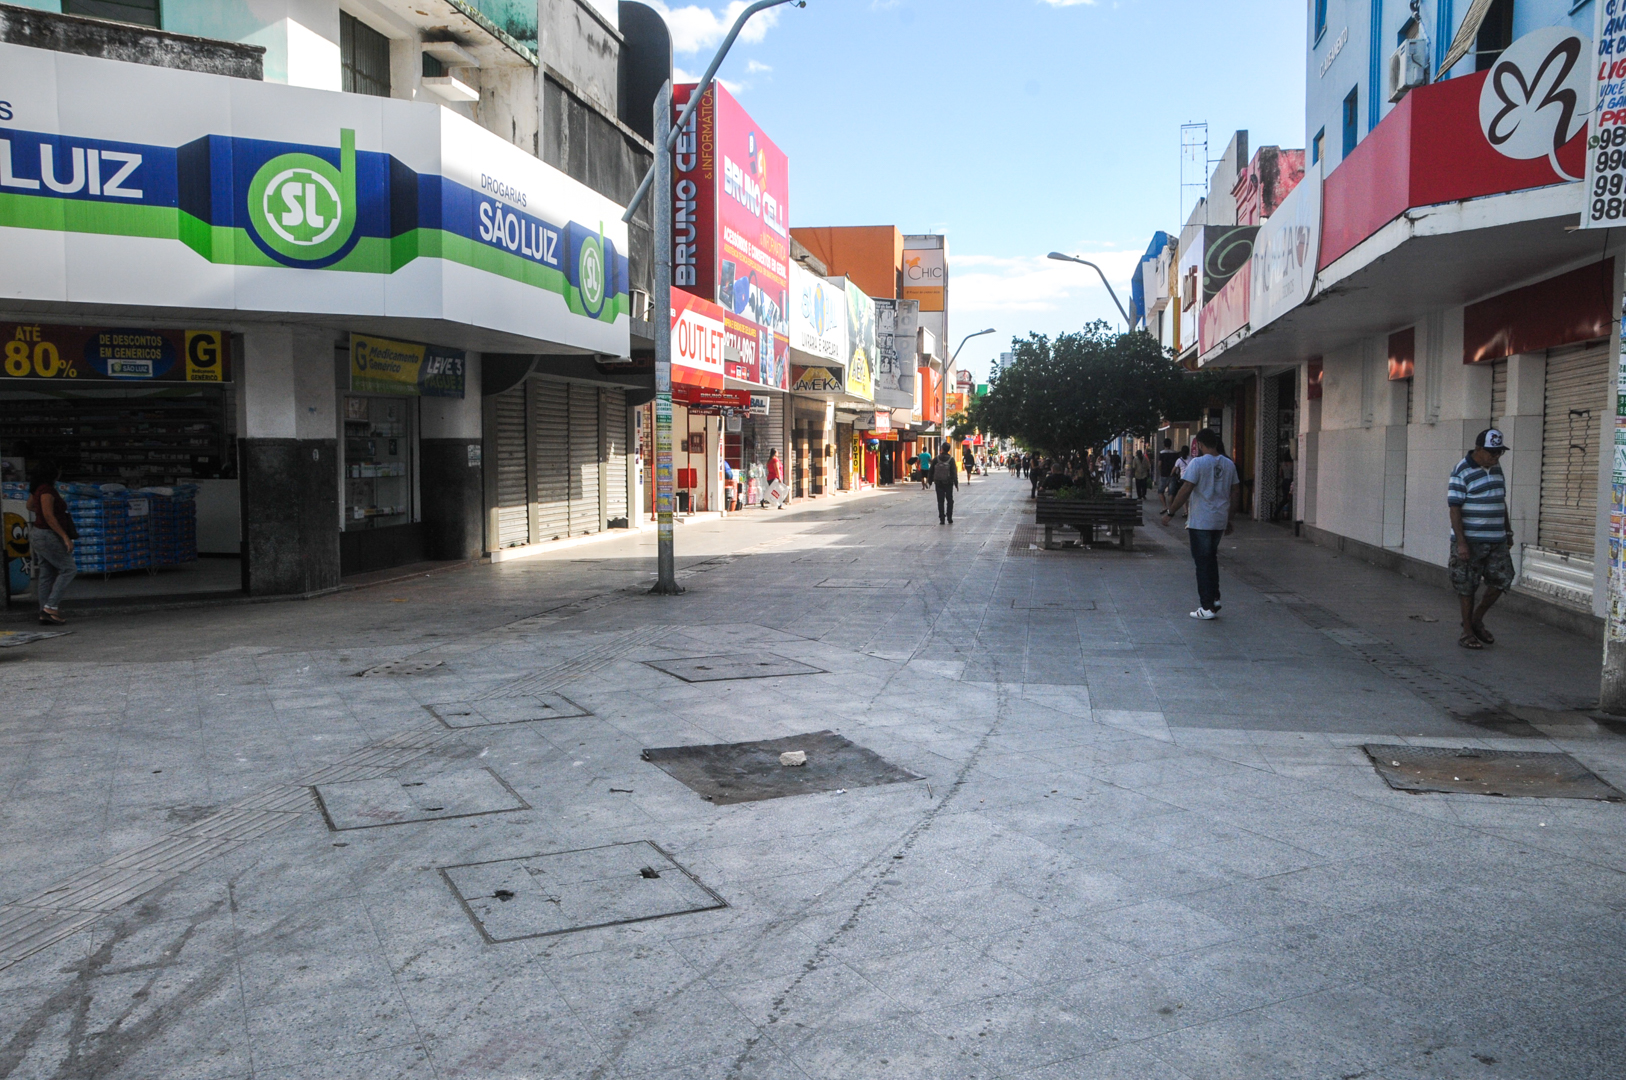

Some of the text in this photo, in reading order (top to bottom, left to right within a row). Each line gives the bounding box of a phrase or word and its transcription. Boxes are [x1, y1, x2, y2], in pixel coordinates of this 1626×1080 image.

[1598, 39, 1615, 56] DE
[698, 88, 713, 180] & INFORMÁTICA
[0, 138, 143, 199] LUIZ
[481, 172, 527, 208] DROGARIAS
[723, 154, 787, 240] BRUNO CELL
[280, 181, 325, 229] SL
[479, 201, 558, 266] SÃO LUIZ
[675, 178, 698, 286] BRUNO
[723, 225, 748, 255] ACESSÓRIOS
[586, 256, 598, 291] SL
[907, 264, 943, 282] CHIC
[15, 324, 41, 341] ATÉ
[100, 334, 162, 347] DE DESCONTOS
[678, 318, 724, 366] OUTLET
[801, 331, 818, 349] LIVRARIA
[822, 340, 840, 357] PAPELARIA
[100, 347, 162, 360] EM GENÉRICOS
[188, 333, 217, 368] G
[355, 341, 368, 371] G
[369, 347, 419, 364] Medicamento
[122, 364, 136, 372] SÃO
[369, 358, 401, 373] Genérico
[426, 356, 463, 376] LEVE 3
[424, 374, 456, 390] PAGUE
[793, 377, 842, 391] JAMEIKA
